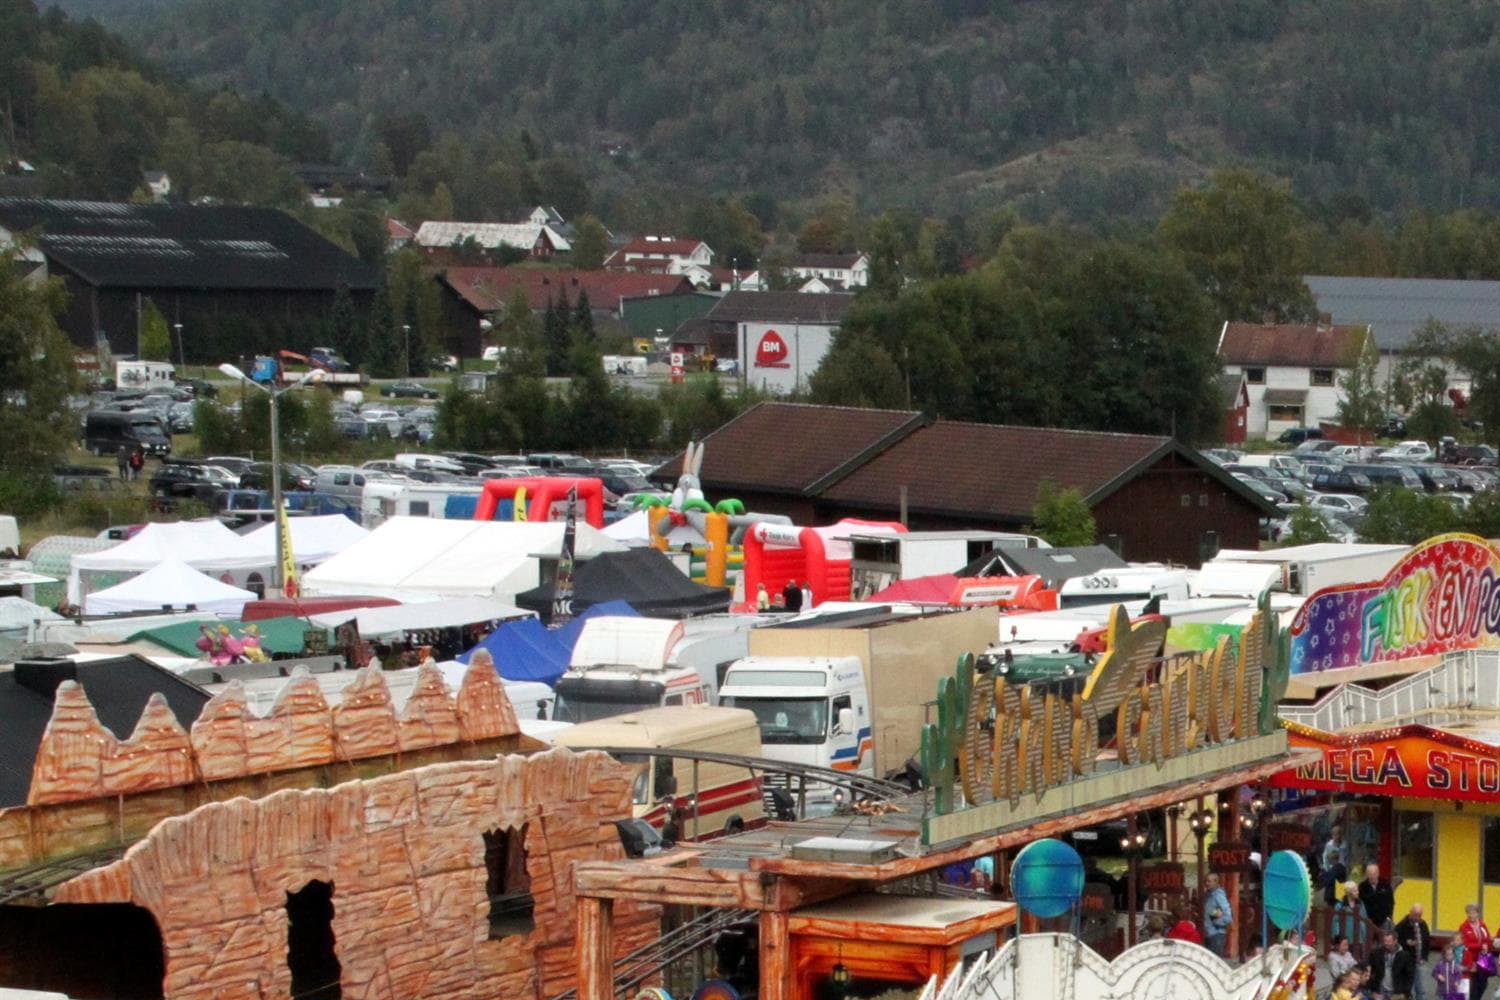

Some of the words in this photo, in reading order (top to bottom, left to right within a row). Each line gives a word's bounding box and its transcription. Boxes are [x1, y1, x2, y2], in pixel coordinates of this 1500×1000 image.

[763, 341, 780, 353] BM
[1361, 566, 1435, 662] FISK
[1433, 564, 1474, 641] EN
[1296, 746, 1413, 787] MEGA
